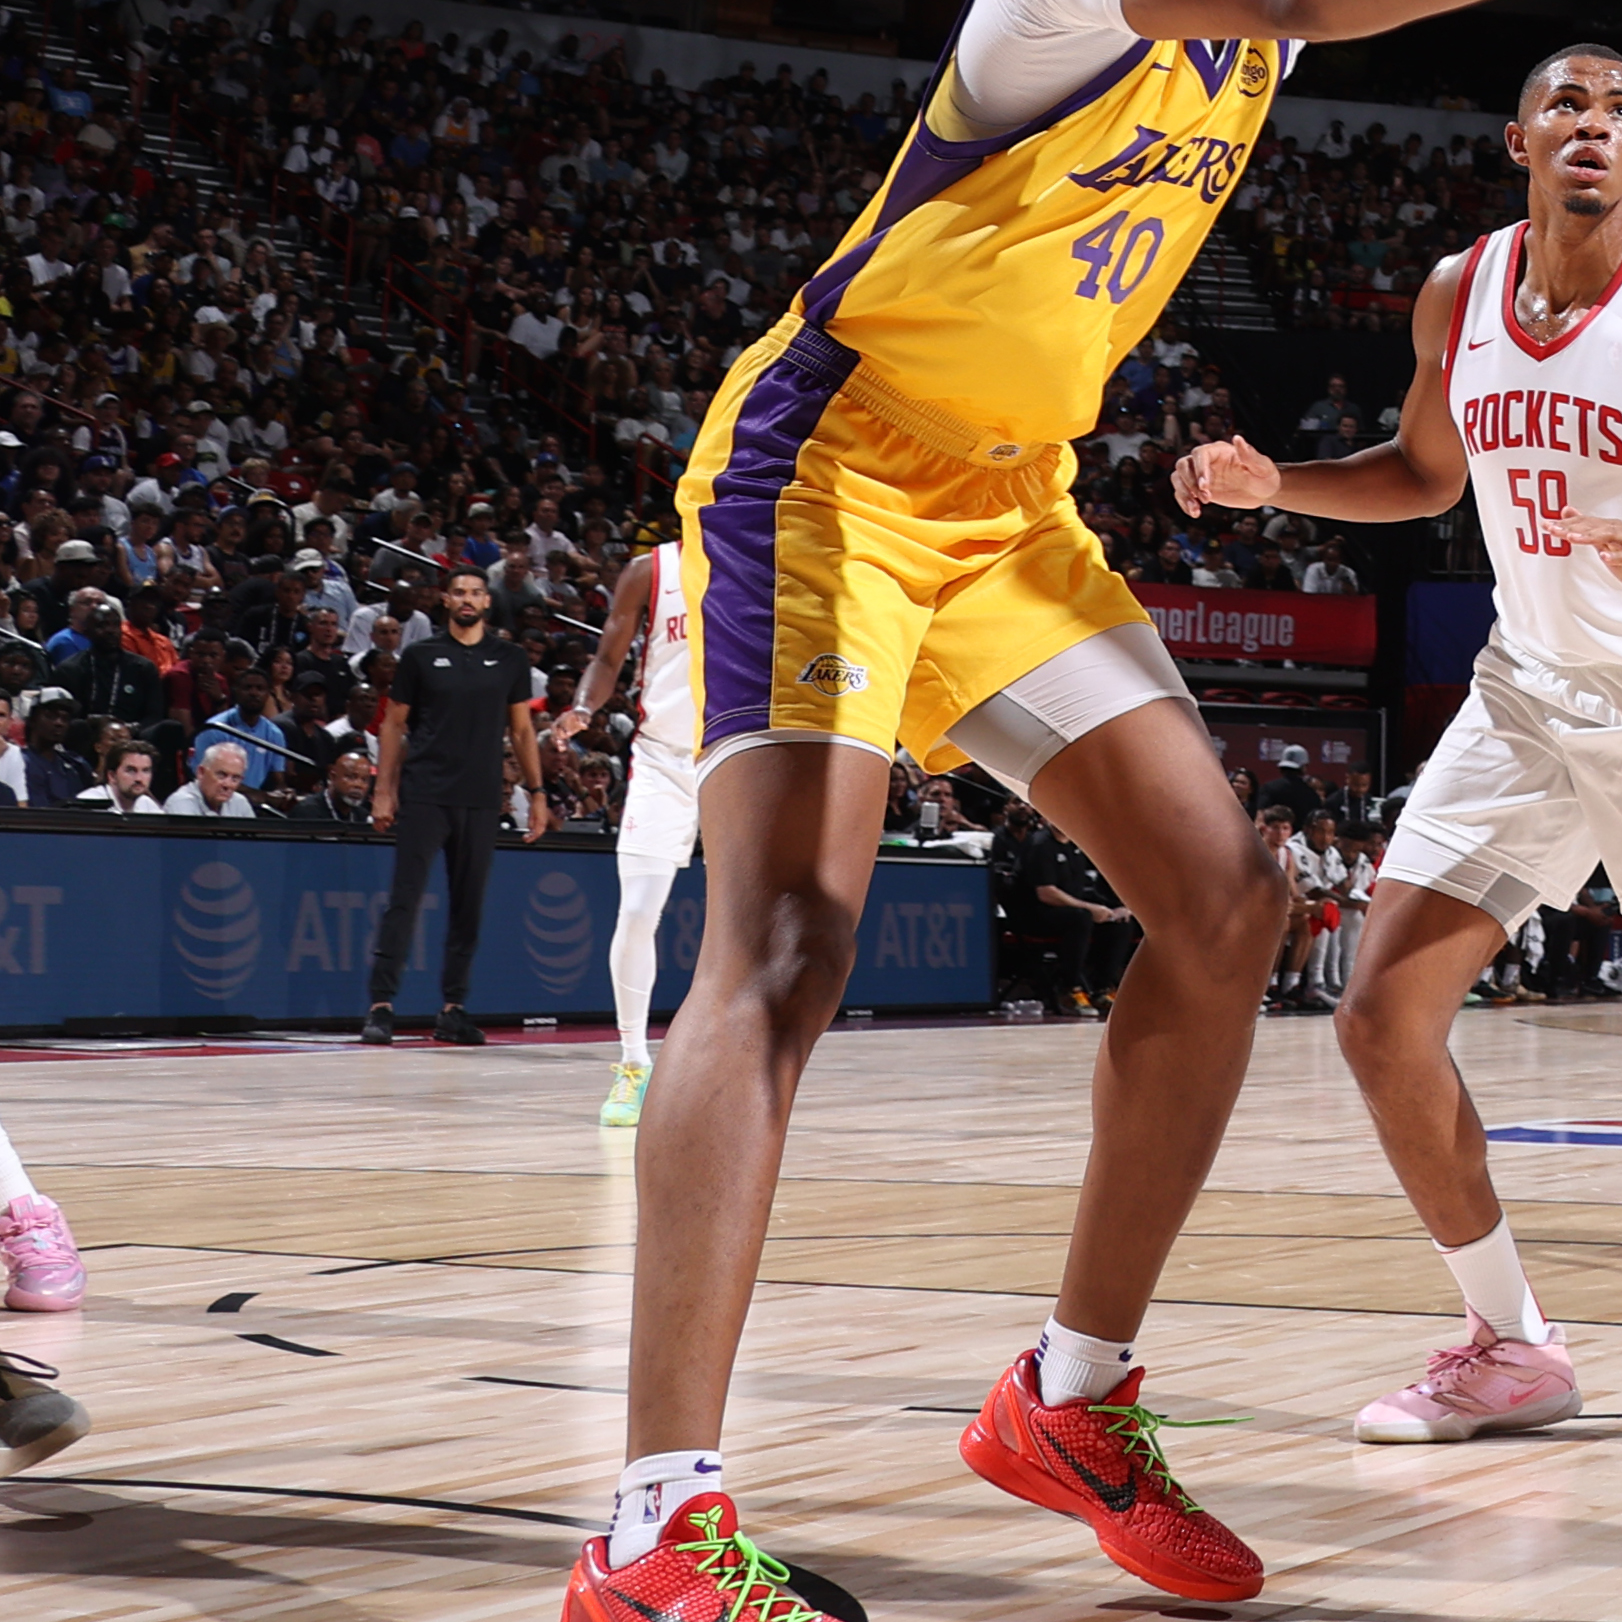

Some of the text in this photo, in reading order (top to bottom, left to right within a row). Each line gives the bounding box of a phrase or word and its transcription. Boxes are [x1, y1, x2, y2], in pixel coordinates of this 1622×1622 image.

[1071, 209, 1165, 305] 40
[797, 662, 868, 691] LAKERS
[874, 901, 976, 969] AT&T
